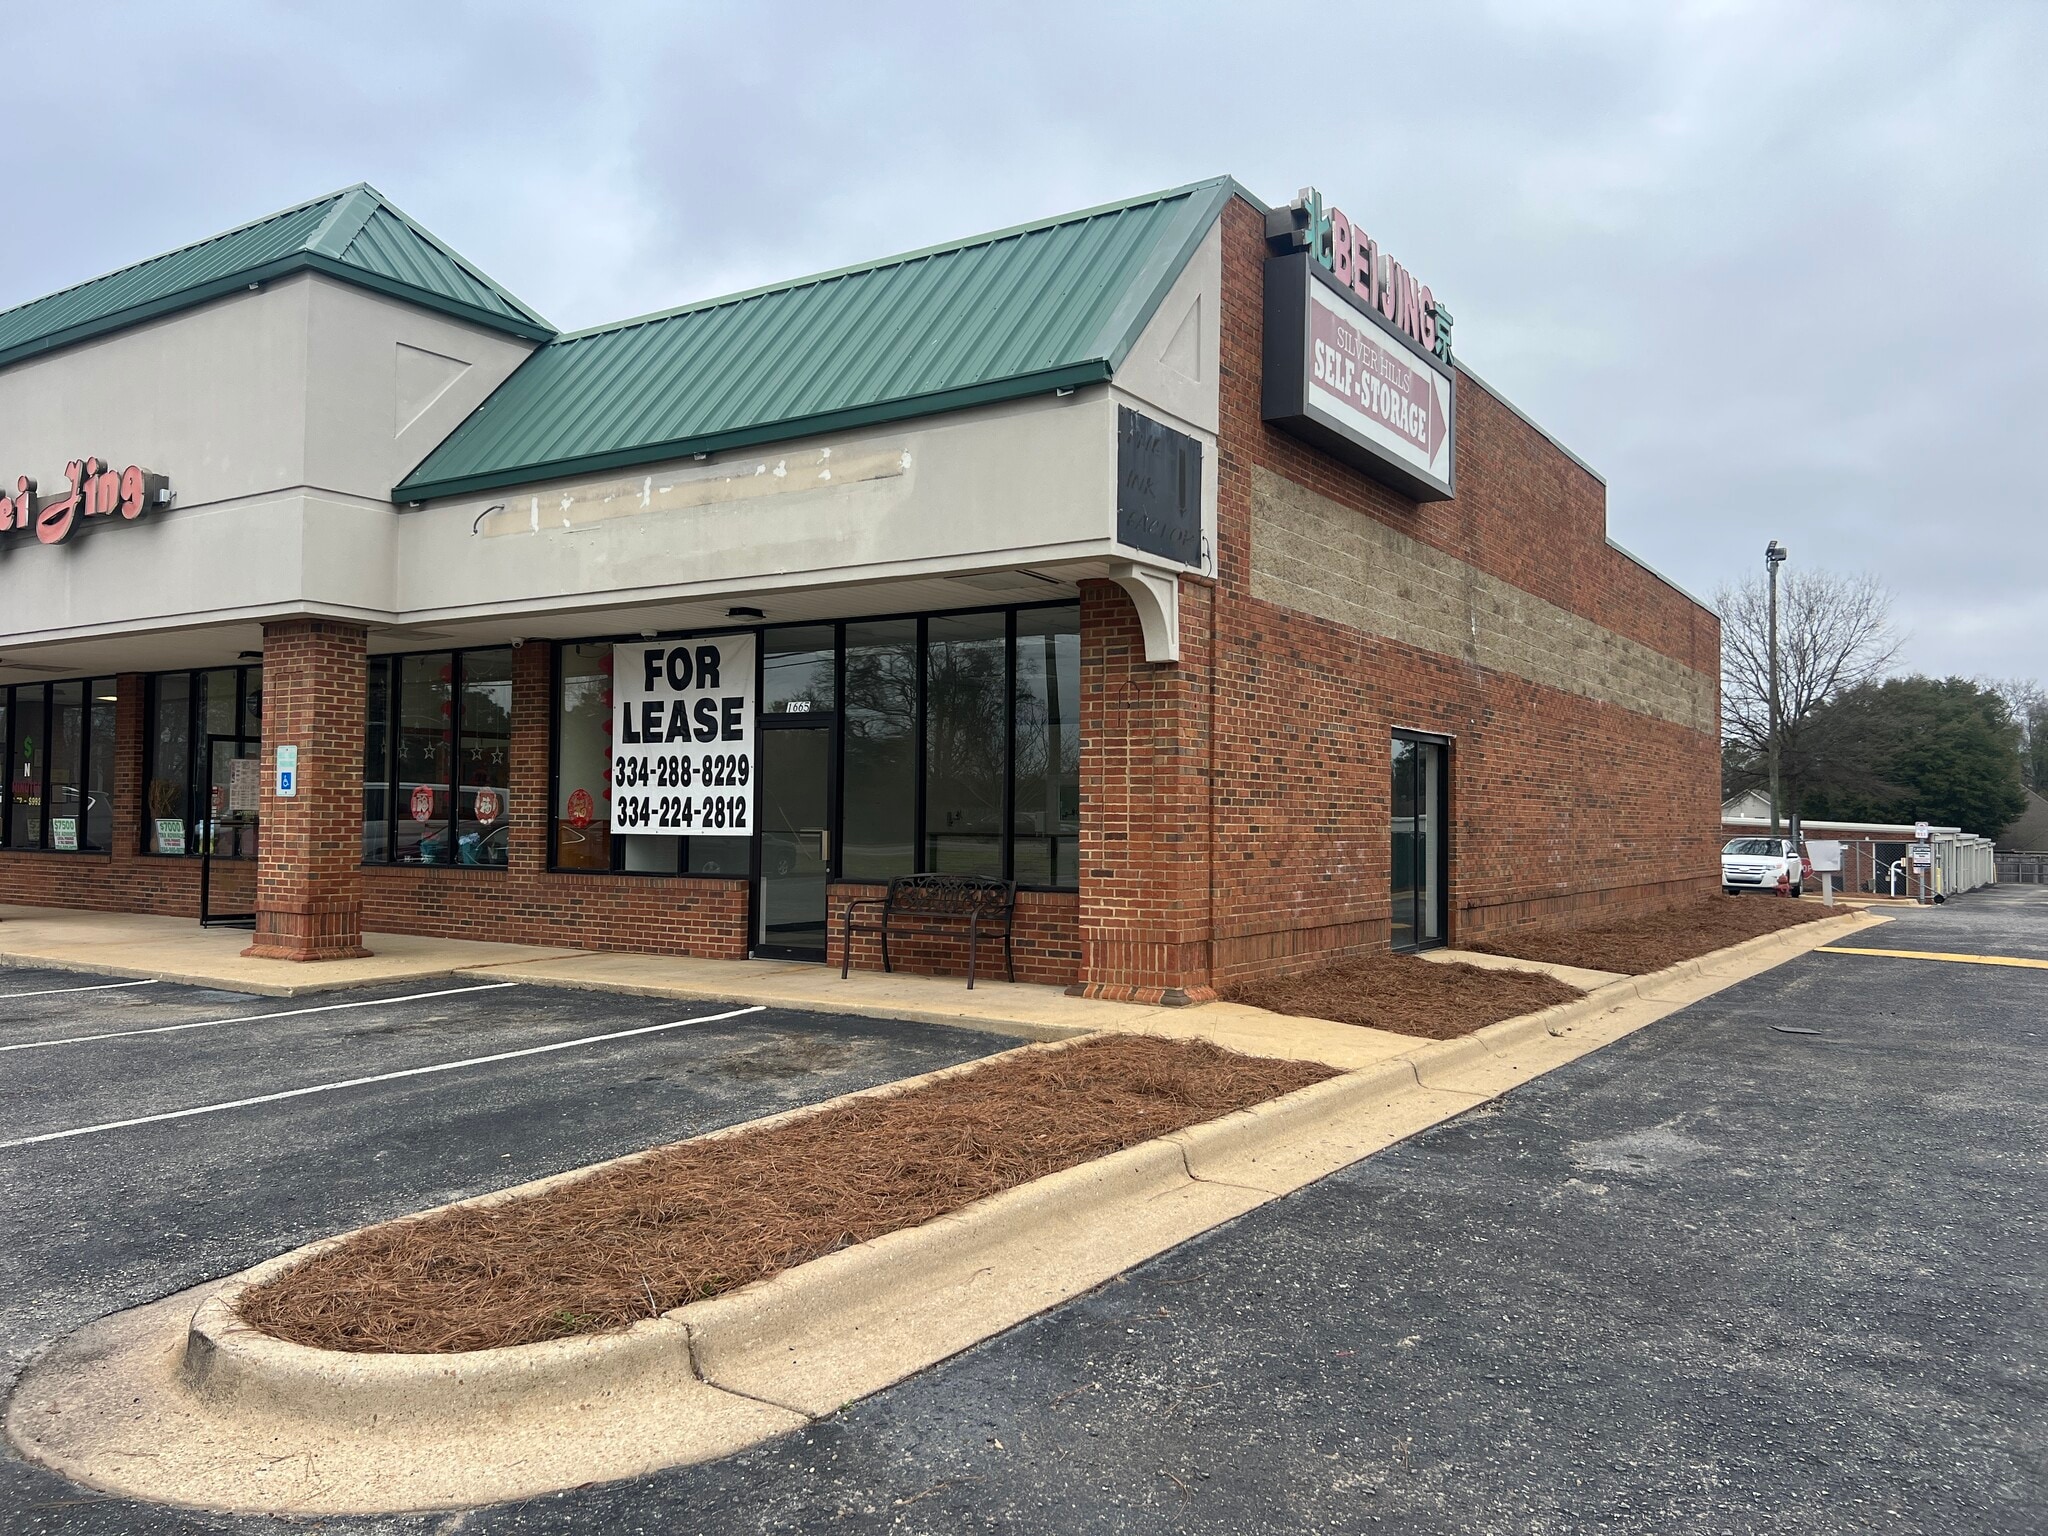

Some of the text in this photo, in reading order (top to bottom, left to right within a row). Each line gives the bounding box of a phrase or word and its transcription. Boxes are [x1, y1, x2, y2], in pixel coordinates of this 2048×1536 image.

[1333, 206, 1436, 351] BEIJING
[1337, 326, 1411, 393] SILVER HILLS
[1314, 338, 1427, 444] SELF-STORAGE
[36, 456, 145, 544] Jing
[644, 645, 721, 692] FOR
[622, 697, 744, 744] LEASE
[787, 701, 810, 713] 1665
[615, 754, 750, 787] 334-288-8229
[54, 820, 75, 830] $7500
[160, 822, 181, 832] $7000
[617, 795, 746, 829] 334-224-2812
